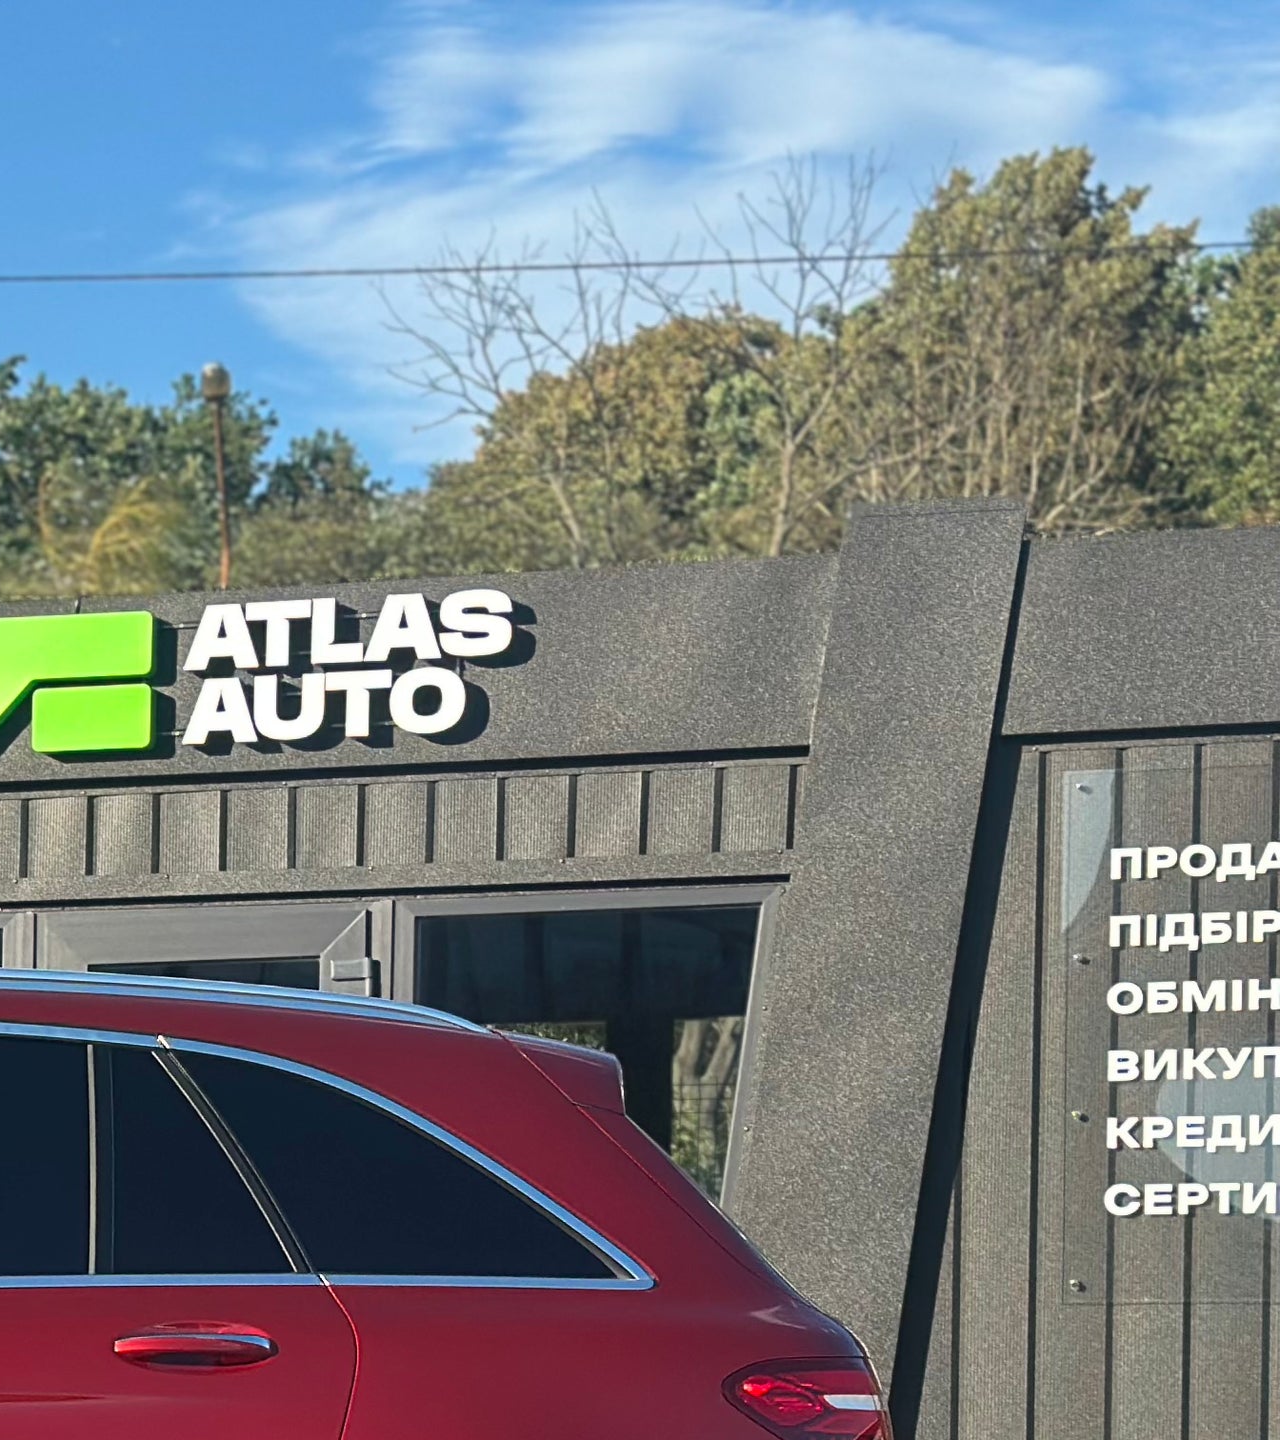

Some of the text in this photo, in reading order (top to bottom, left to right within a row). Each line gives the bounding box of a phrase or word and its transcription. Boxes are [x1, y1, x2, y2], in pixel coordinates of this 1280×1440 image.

[182, 588, 514, 672] ATLAS
[181, 666, 467, 746] AUTO
[1109, 910, 1280, 952] ПІДБІР
[1106, 978, 1280, 1015] ОБМІН
[1107, 1046, 1280, 1082] ВИКУП
[1106, 1113, 1280, 1153] КРЕДИ
[1103, 1181, 1278, 1216] СЕРТИ
